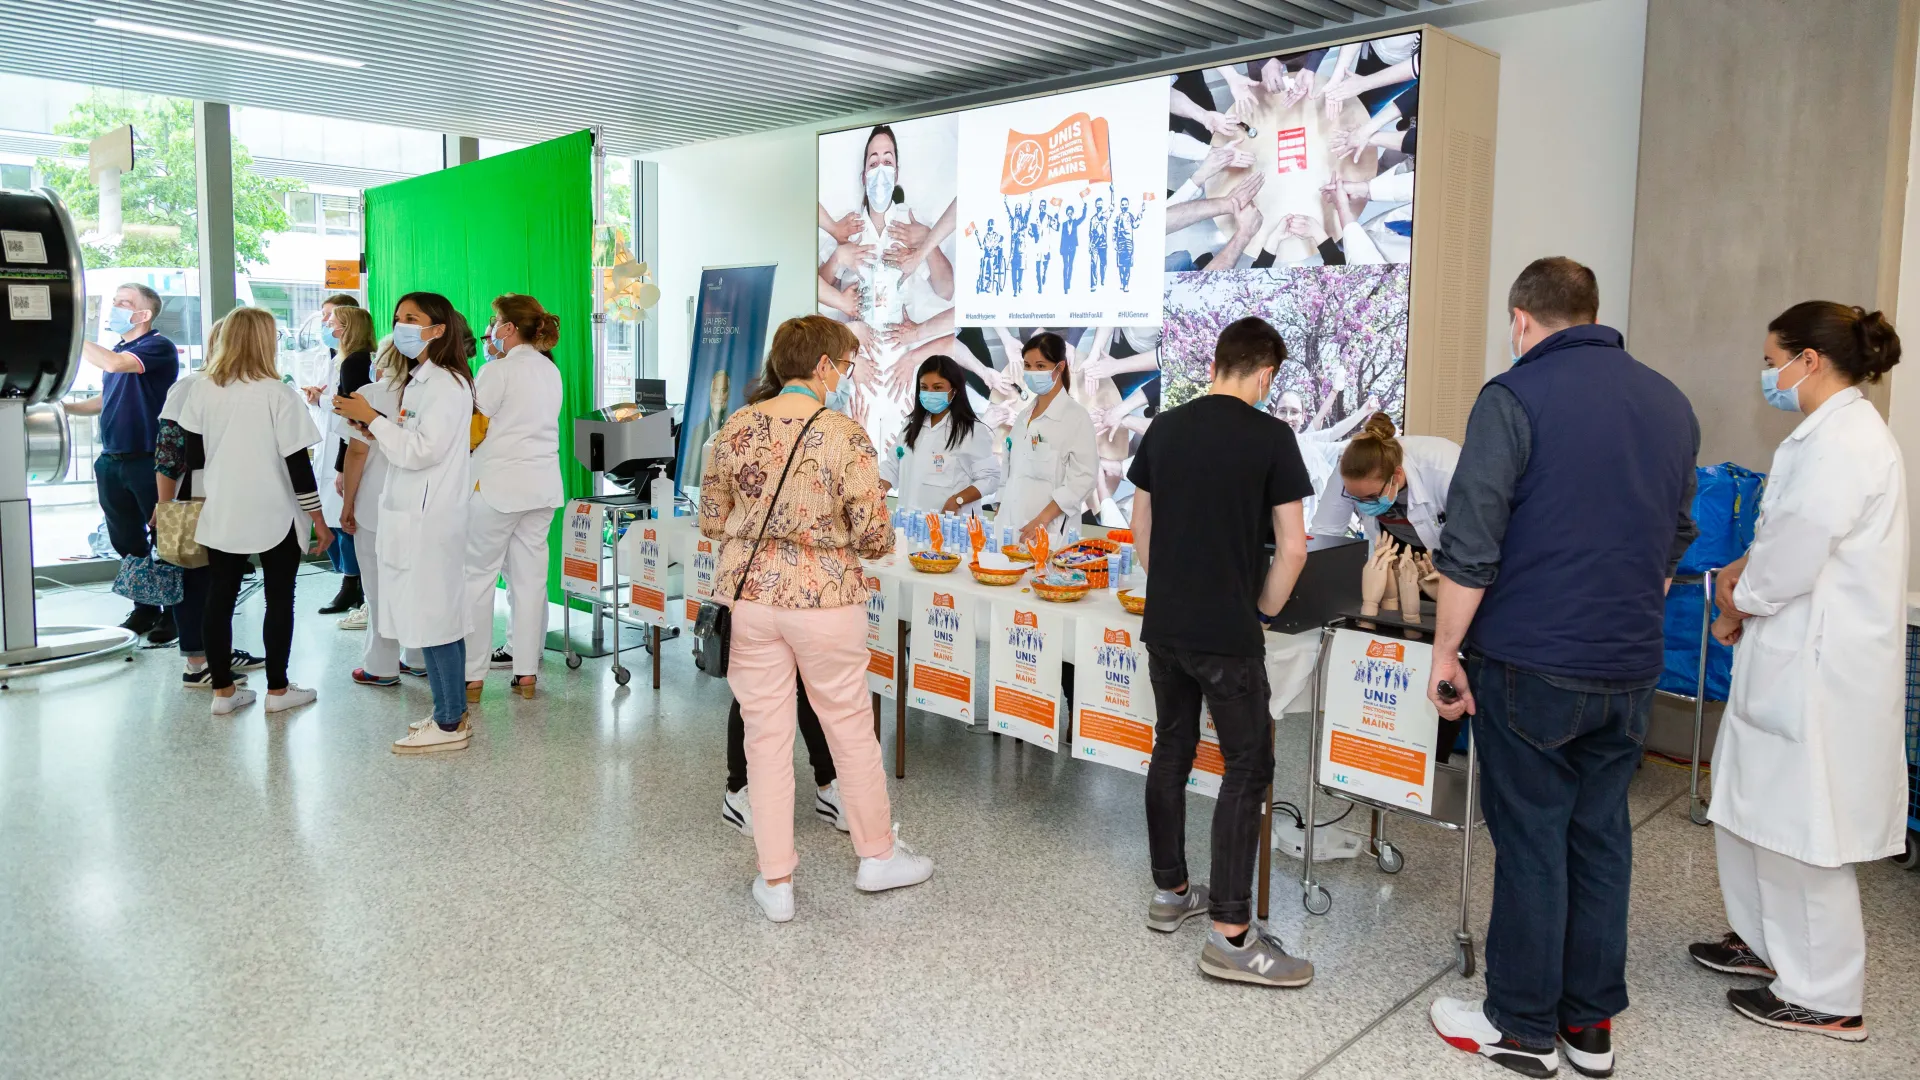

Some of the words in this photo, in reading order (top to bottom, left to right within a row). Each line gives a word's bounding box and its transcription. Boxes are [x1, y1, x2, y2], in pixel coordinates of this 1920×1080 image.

[1048, 121, 1082, 150] UNIS
[1048, 160, 1087, 180] MAINS
[698, 571, 710, 580] UNIS
[934, 630, 954, 643] UNIS
[934, 652, 953, 662] MAINS
[1016, 650, 1037, 664] UNIS
[1016, 673, 1037, 685] MAINS
[1105, 670, 1130, 685] UNIS
[1105, 695, 1130, 707] MAINS
[1364, 688, 1397, 706] UNIS
[1363, 705, 1396, 716] FRICTIONNEZ
[1362, 716, 1395, 731] MAINS
[1082, 746, 1096, 756] HUG
[1332, 773, 1349, 784] HUG
[1247, 953, 1275, 974] N
